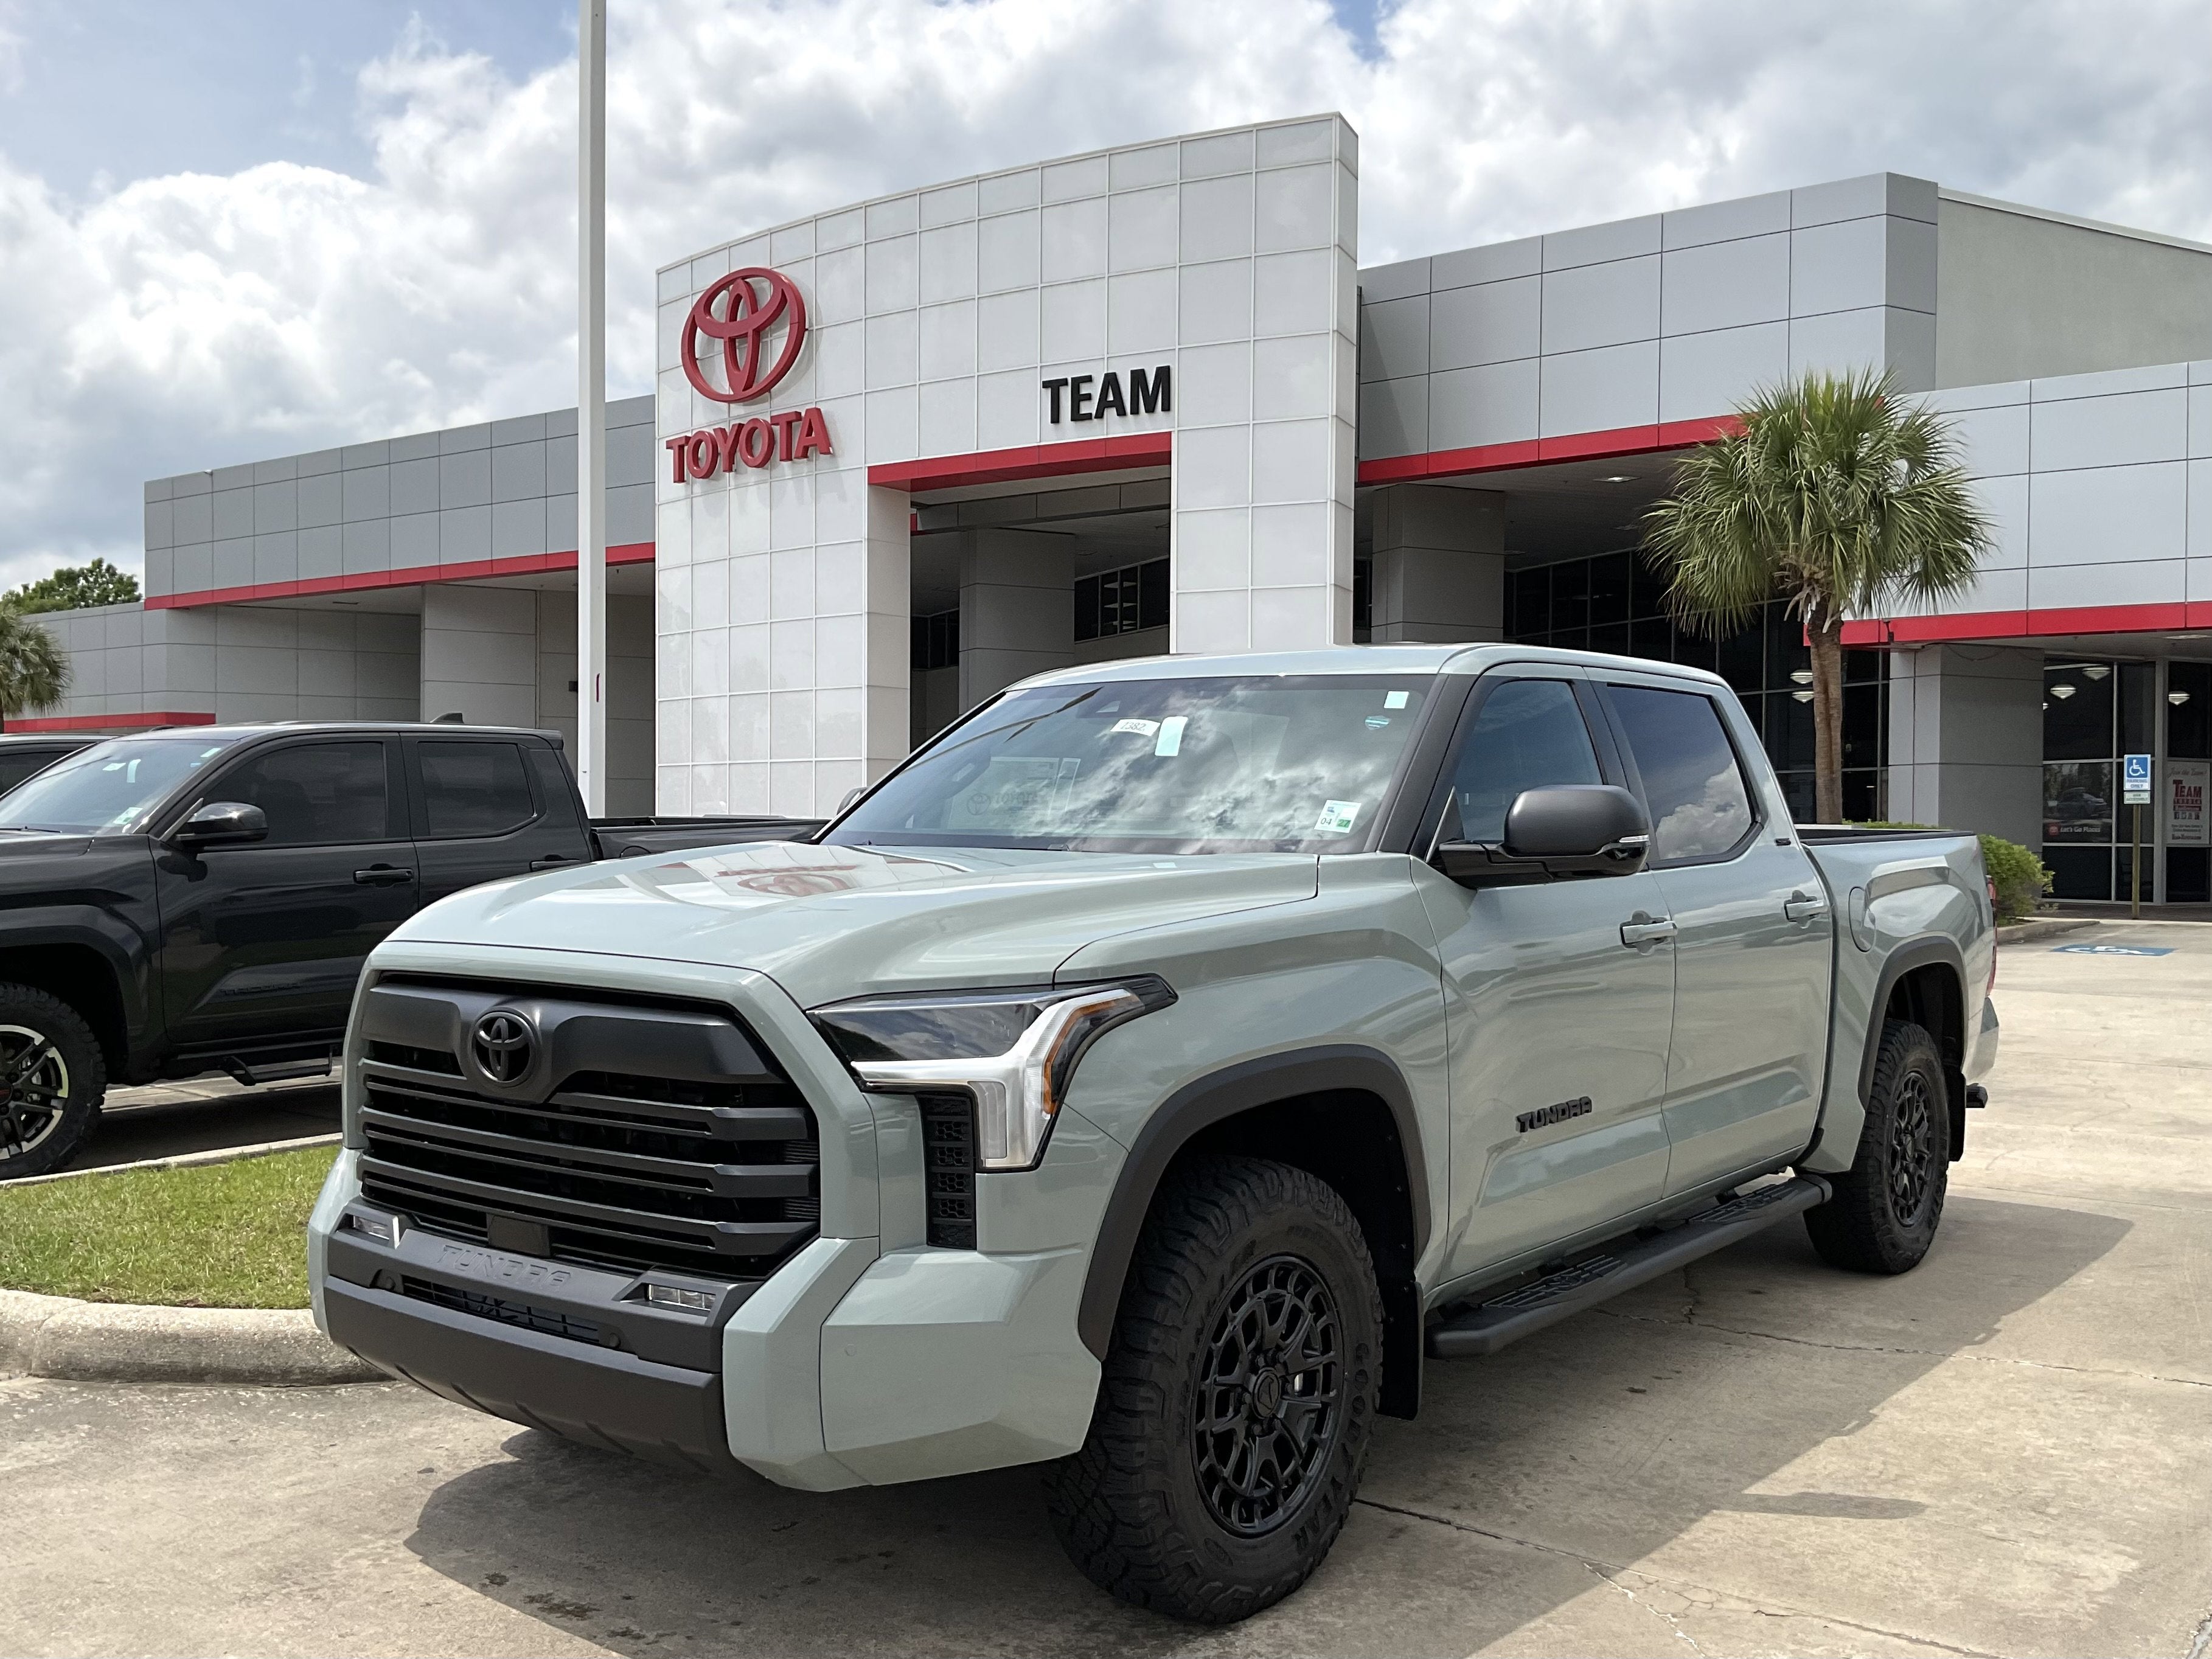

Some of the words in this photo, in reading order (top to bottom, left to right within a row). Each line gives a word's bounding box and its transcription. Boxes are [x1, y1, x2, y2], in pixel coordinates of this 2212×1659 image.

[1042, 365, 1170, 423] TEAM
[666, 407, 833, 483] TOYOTA
[1515, 1096, 1592, 1133] TUNDRA
[435, 1245, 572, 1290] TUNDRA
